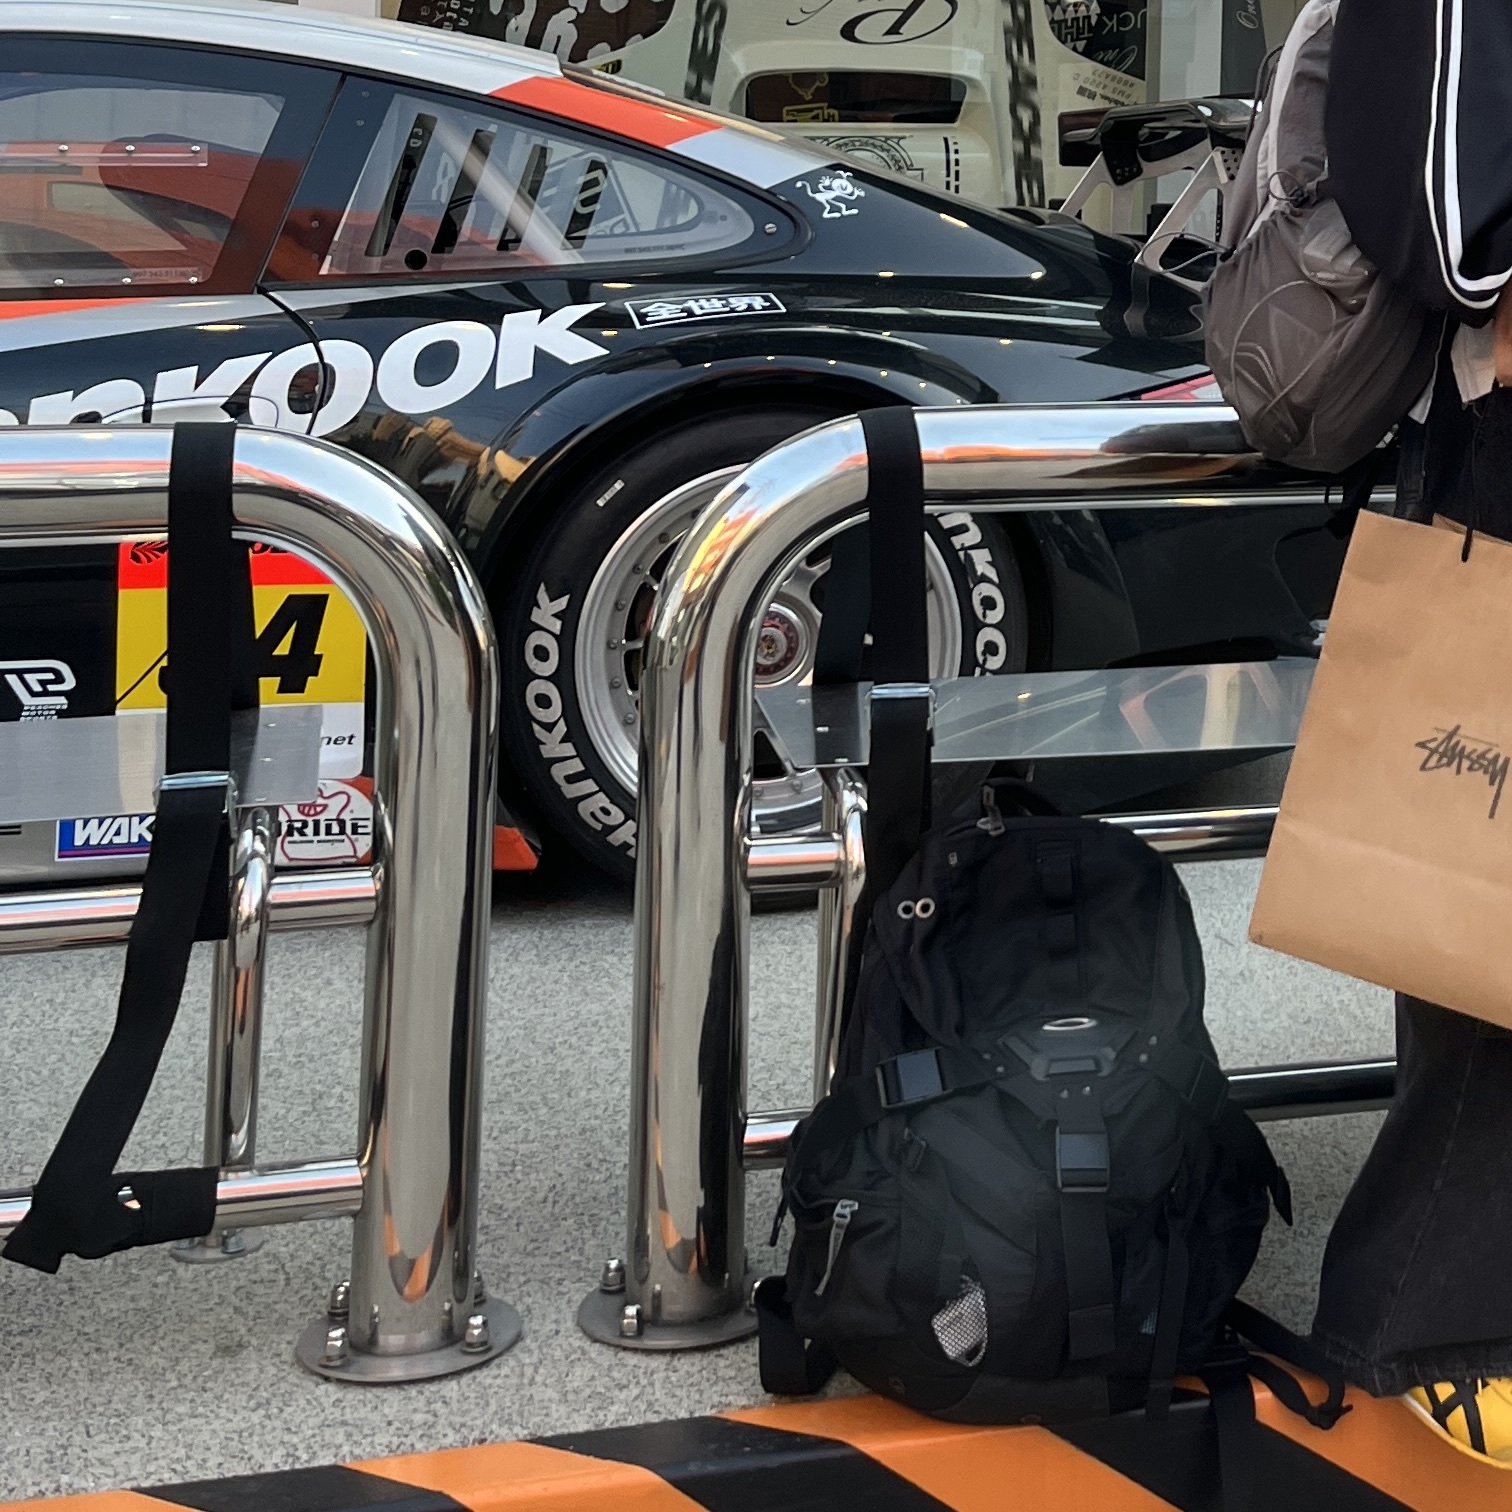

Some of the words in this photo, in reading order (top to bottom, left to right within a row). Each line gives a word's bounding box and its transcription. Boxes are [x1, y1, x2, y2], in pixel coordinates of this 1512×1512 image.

[640, 296, 771, 322] 全世界
[278, 818, 371, 837] RIDE
